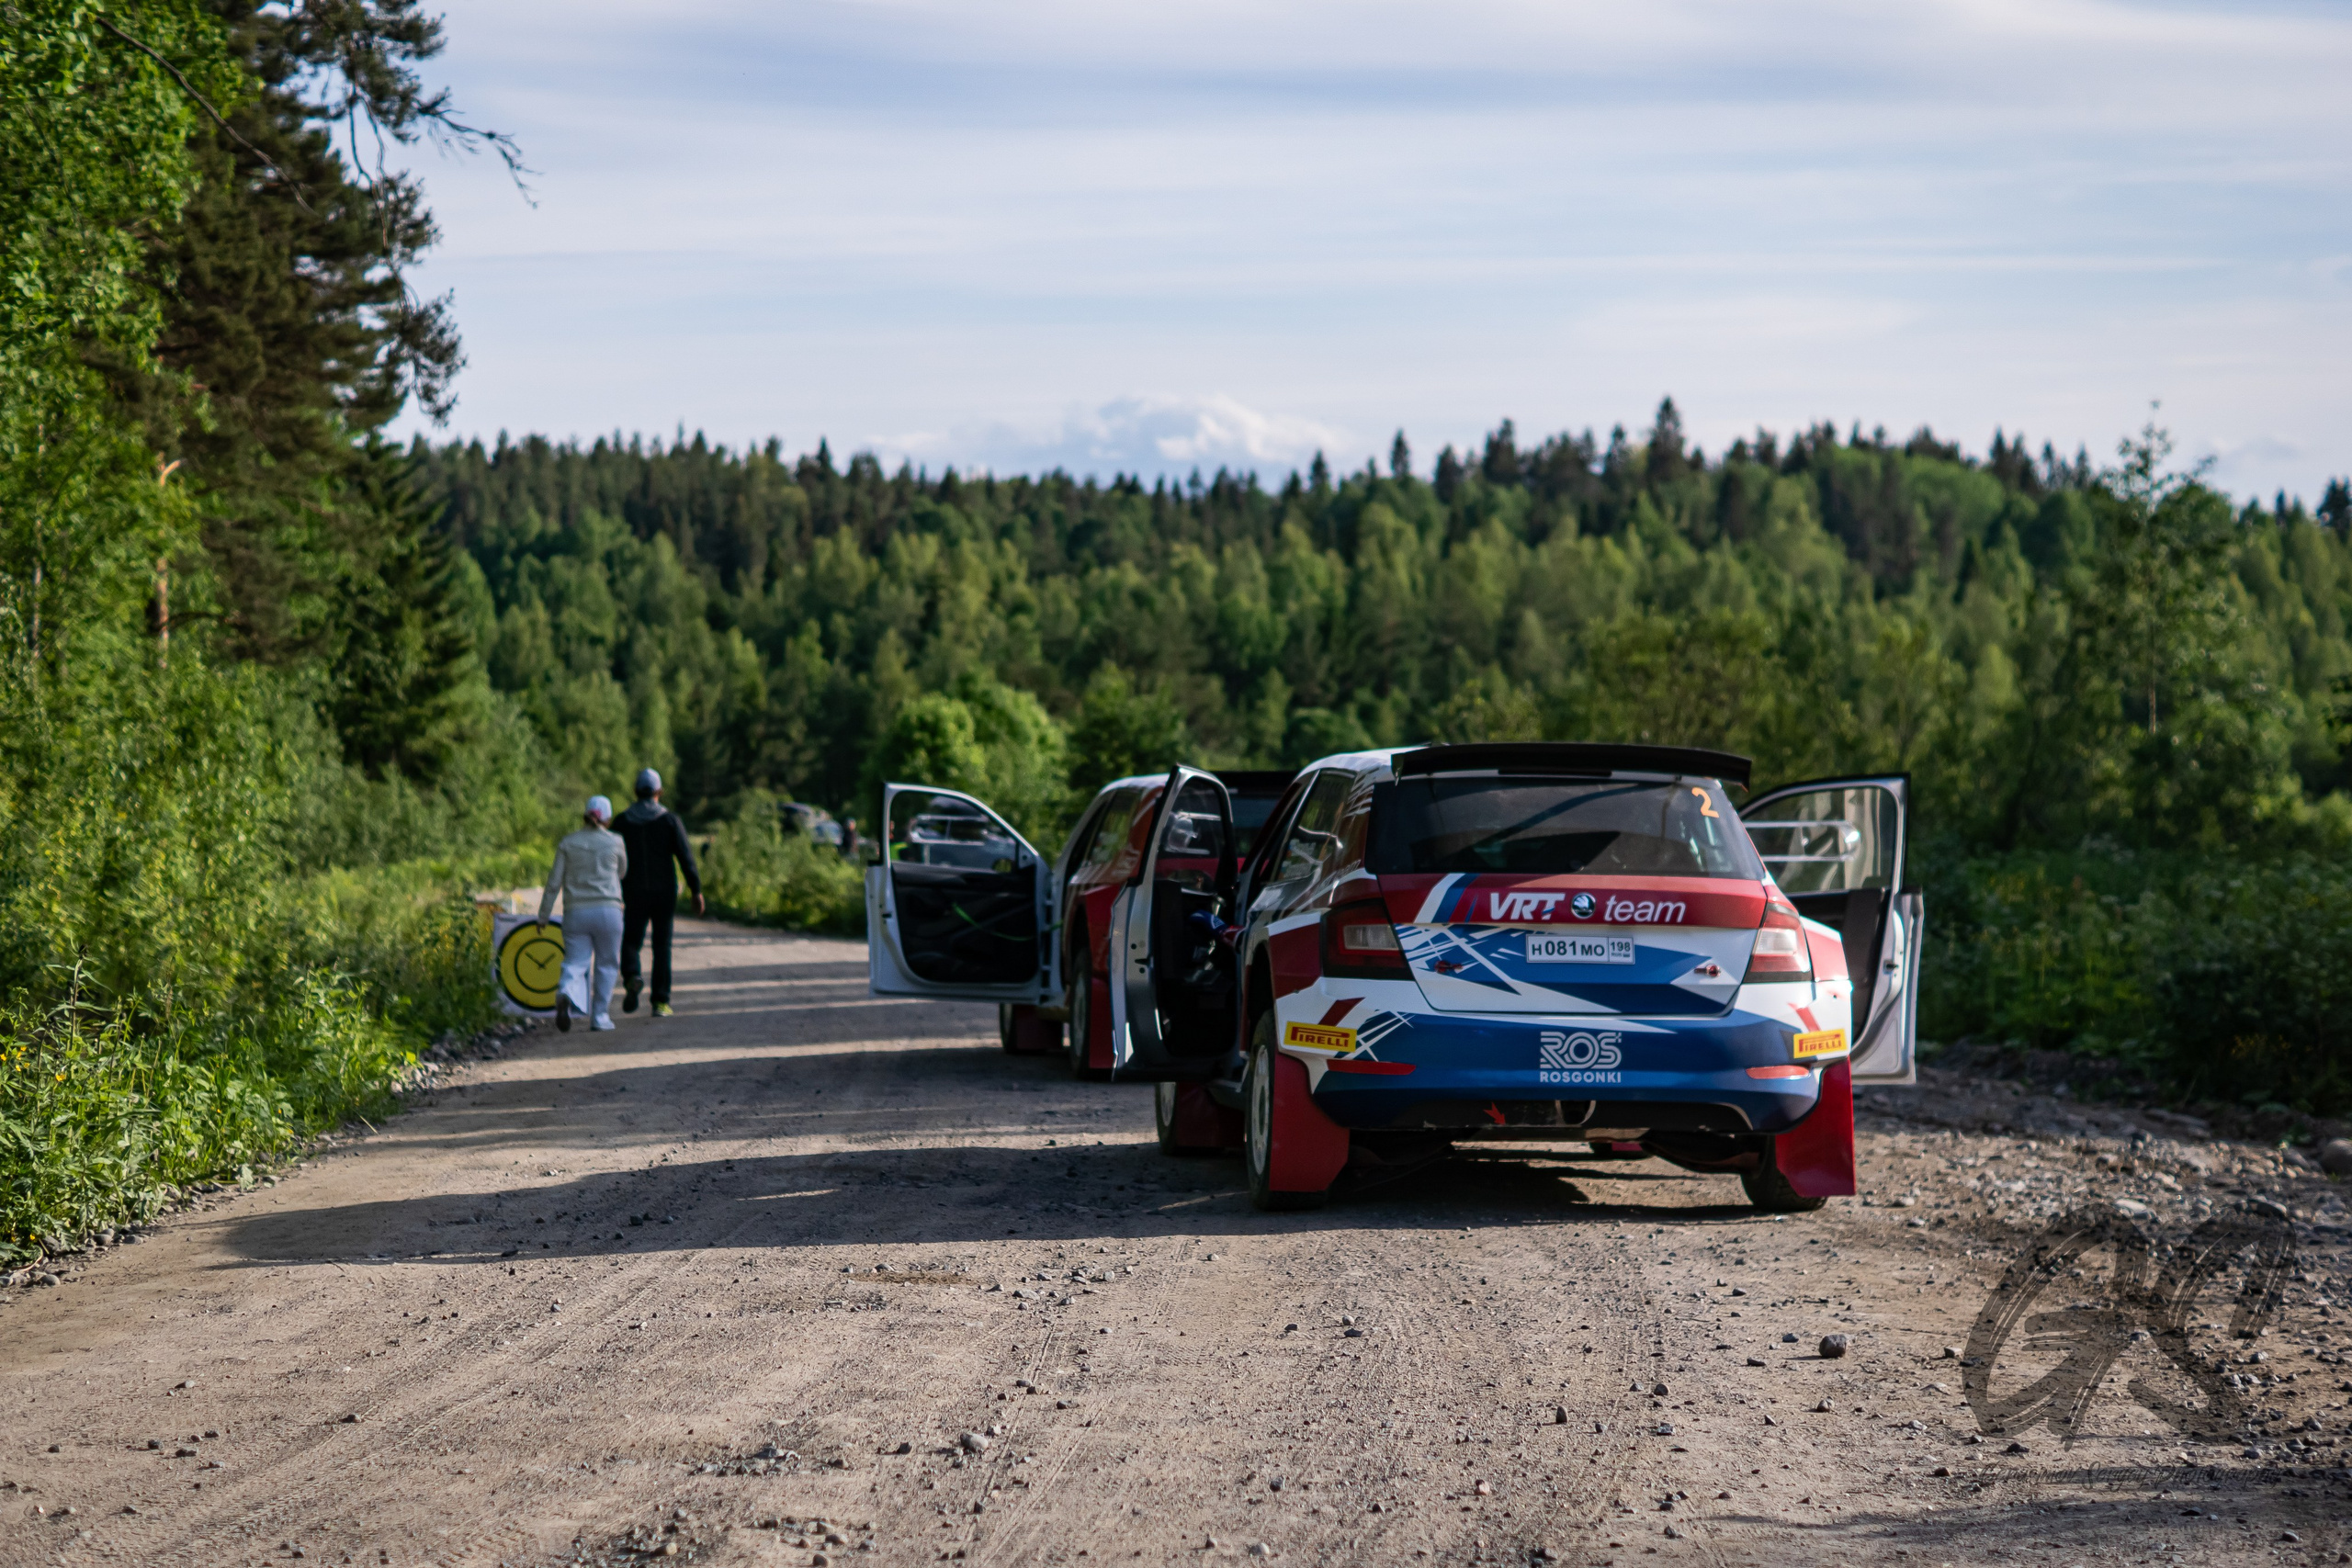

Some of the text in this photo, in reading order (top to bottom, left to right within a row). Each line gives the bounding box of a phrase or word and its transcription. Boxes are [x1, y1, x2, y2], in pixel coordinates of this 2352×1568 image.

[1691, 786, 1720, 818] 2
[1490, 893, 1687, 923] VRT team
[1610, 942, 1631, 953] 198
[1290, 1026, 1350, 1048] PIRELLI
[1798, 1033, 1842, 1053] PIRELLI
[1540, 1032, 1623, 1069] ROS
[1540, 1071, 1622, 1083] ROSGONKI
